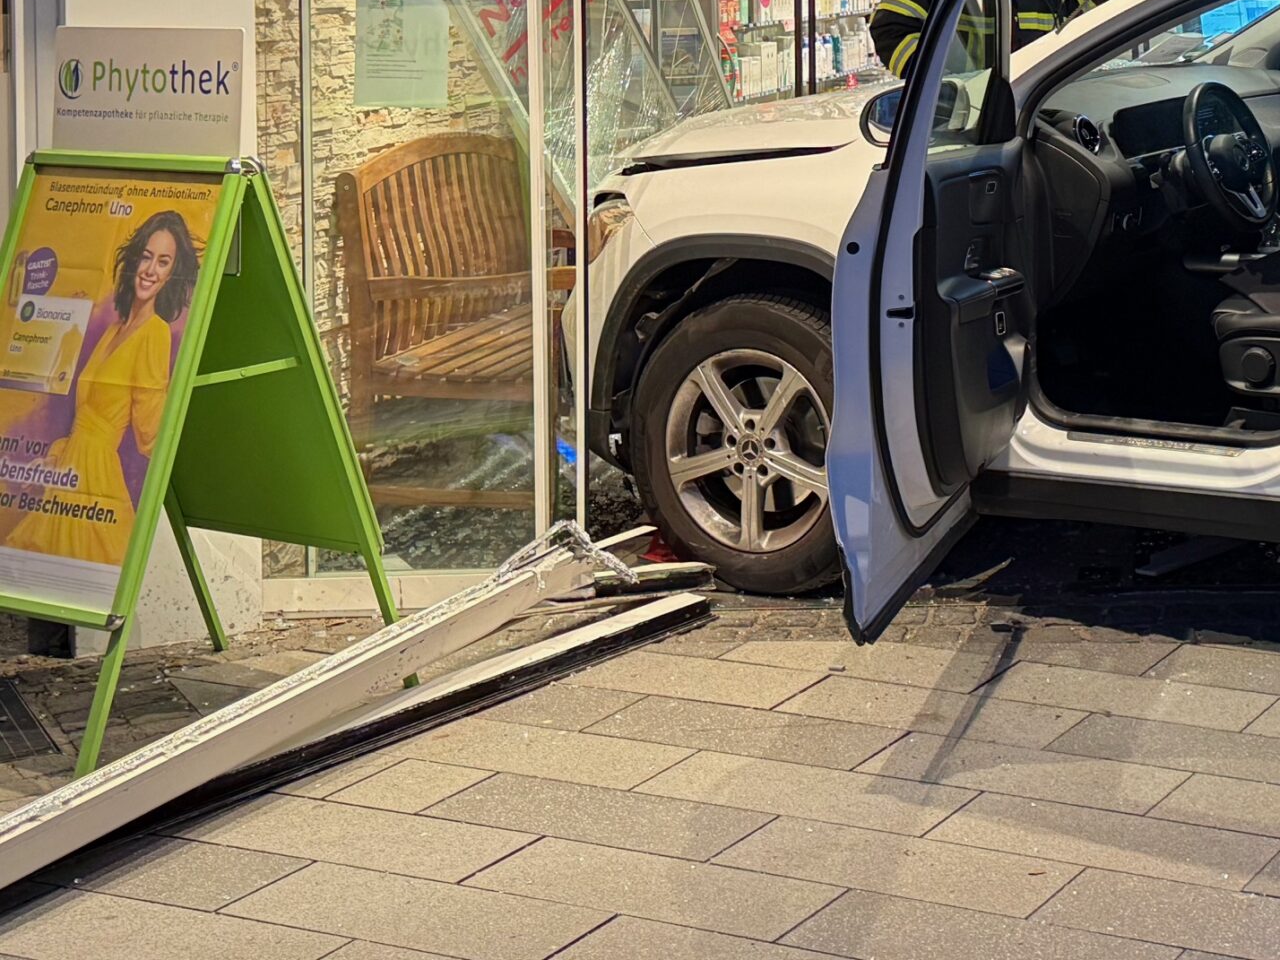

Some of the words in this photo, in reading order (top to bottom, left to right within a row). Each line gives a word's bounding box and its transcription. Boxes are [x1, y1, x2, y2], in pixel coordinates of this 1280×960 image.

[56, 106, 133, 120] Kompetenzapotheke
[135, 111, 147, 120] für
[149, 111, 192, 122] pflanzliche
[195, 112, 229, 123] Therapie
[127, 187, 149, 198] ohne
[150, 186, 211, 201] Antibiotikum?
[109, 200, 133, 216] Uno
[25, 439, 48, 455] vor
[0, 458, 79, 488] bensfreude
[0, 492, 16, 508] or
[18, 491, 118, 525] Beschwerden.
